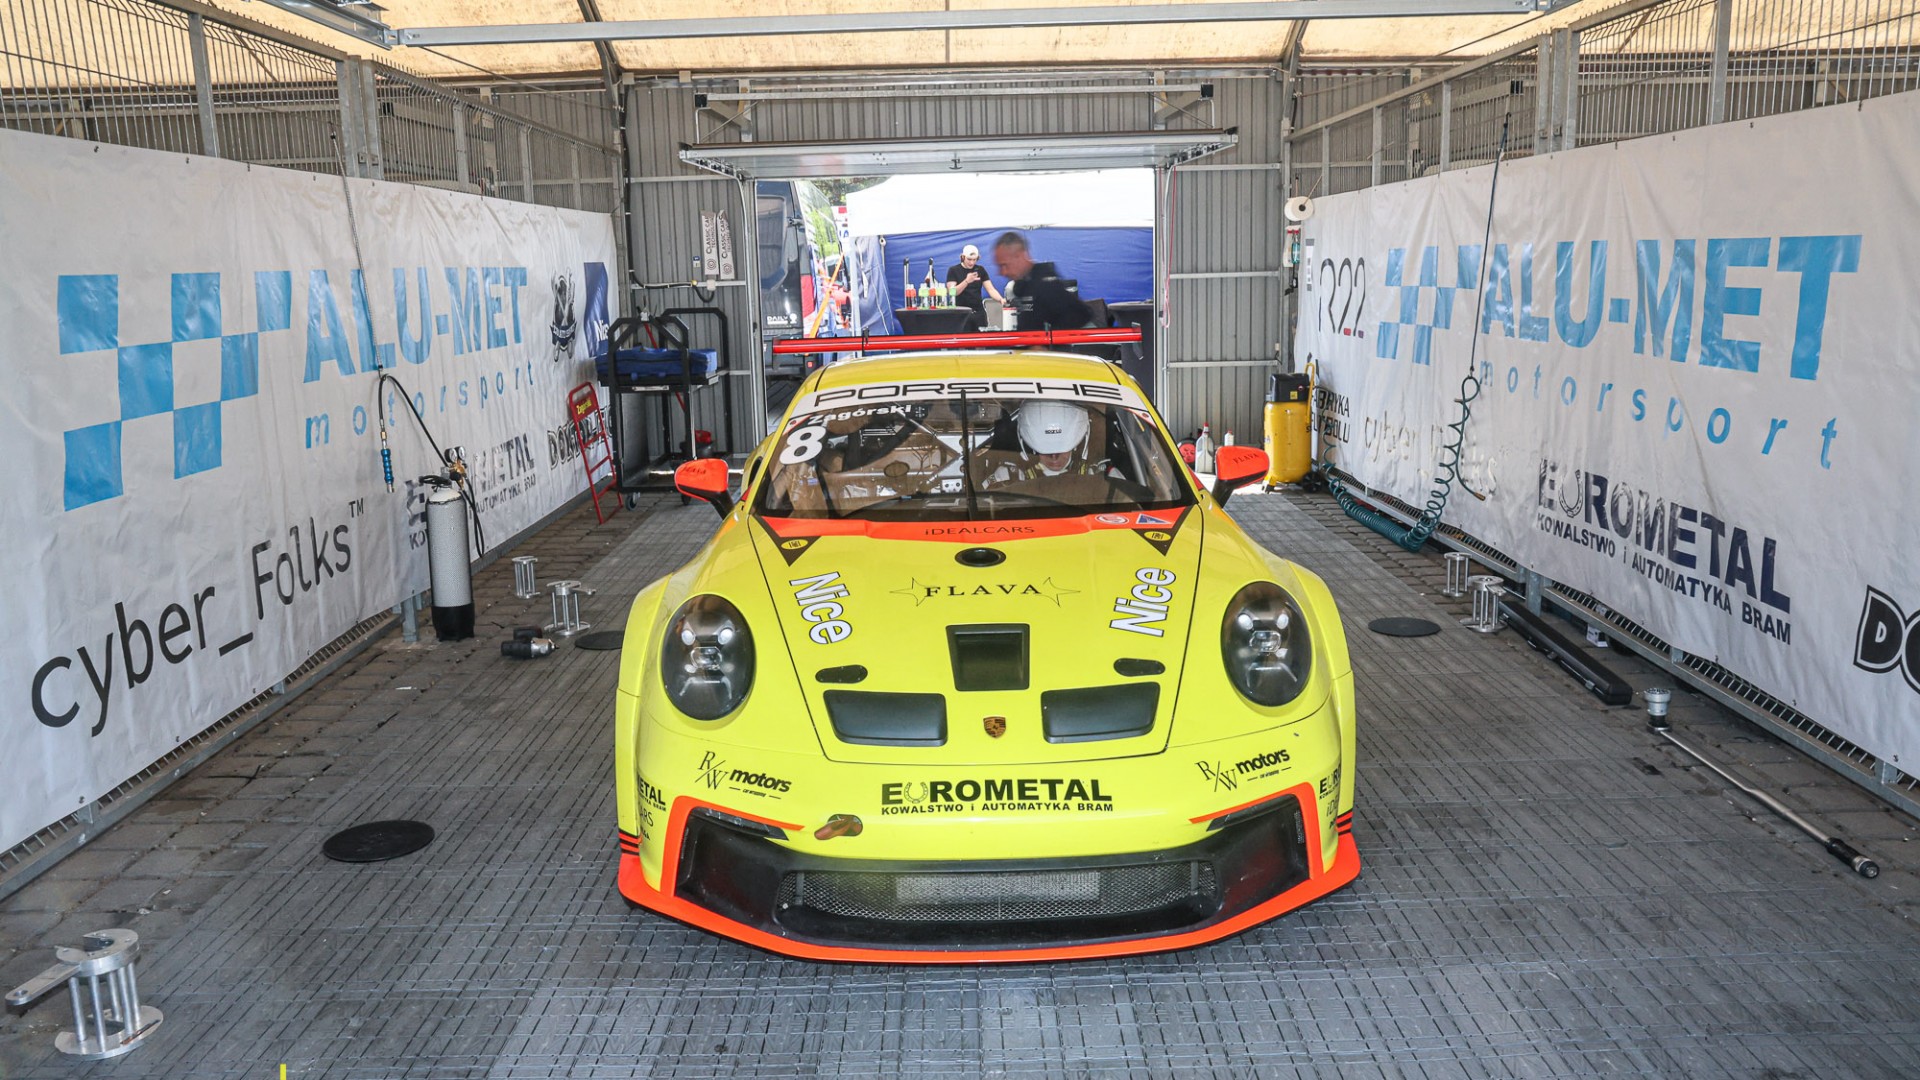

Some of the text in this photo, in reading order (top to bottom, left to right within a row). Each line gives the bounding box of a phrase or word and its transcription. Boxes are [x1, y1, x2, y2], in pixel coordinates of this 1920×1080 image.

[304, 267, 528, 384] ALU-MET
[1481, 235, 1862, 381] ALU-MET
[305, 361, 534, 449] motorsport
[808, 404, 912, 426] Zagórski
[814, 381, 1123, 408] PORSCHE
[1479, 360, 1838, 469] motorsport
[779, 426, 826, 465] 8
[1538, 458, 1790, 614] EUROMETAL
[925, 584, 1041, 597] FLAVA
[1109, 567, 1177, 638] Nice
[1536, 512, 1616, 558] KOWALSTWO
[1632, 551, 1732, 615] AUTOMATYKA
[1741, 602, 1791, 645] BRAM
[789, 571, 853, 645] Nice
[729, 768, 792, 793] motors
[1235, 749, 1290, 775] motors
[881, 803, 964, 815] KOWALSTWO
[982, 802, 1071, 812] AUTOMATYKA
[1077, 802, 1114, 812] BRAM
[882, 778, 1113, 805] EUROMETAL
